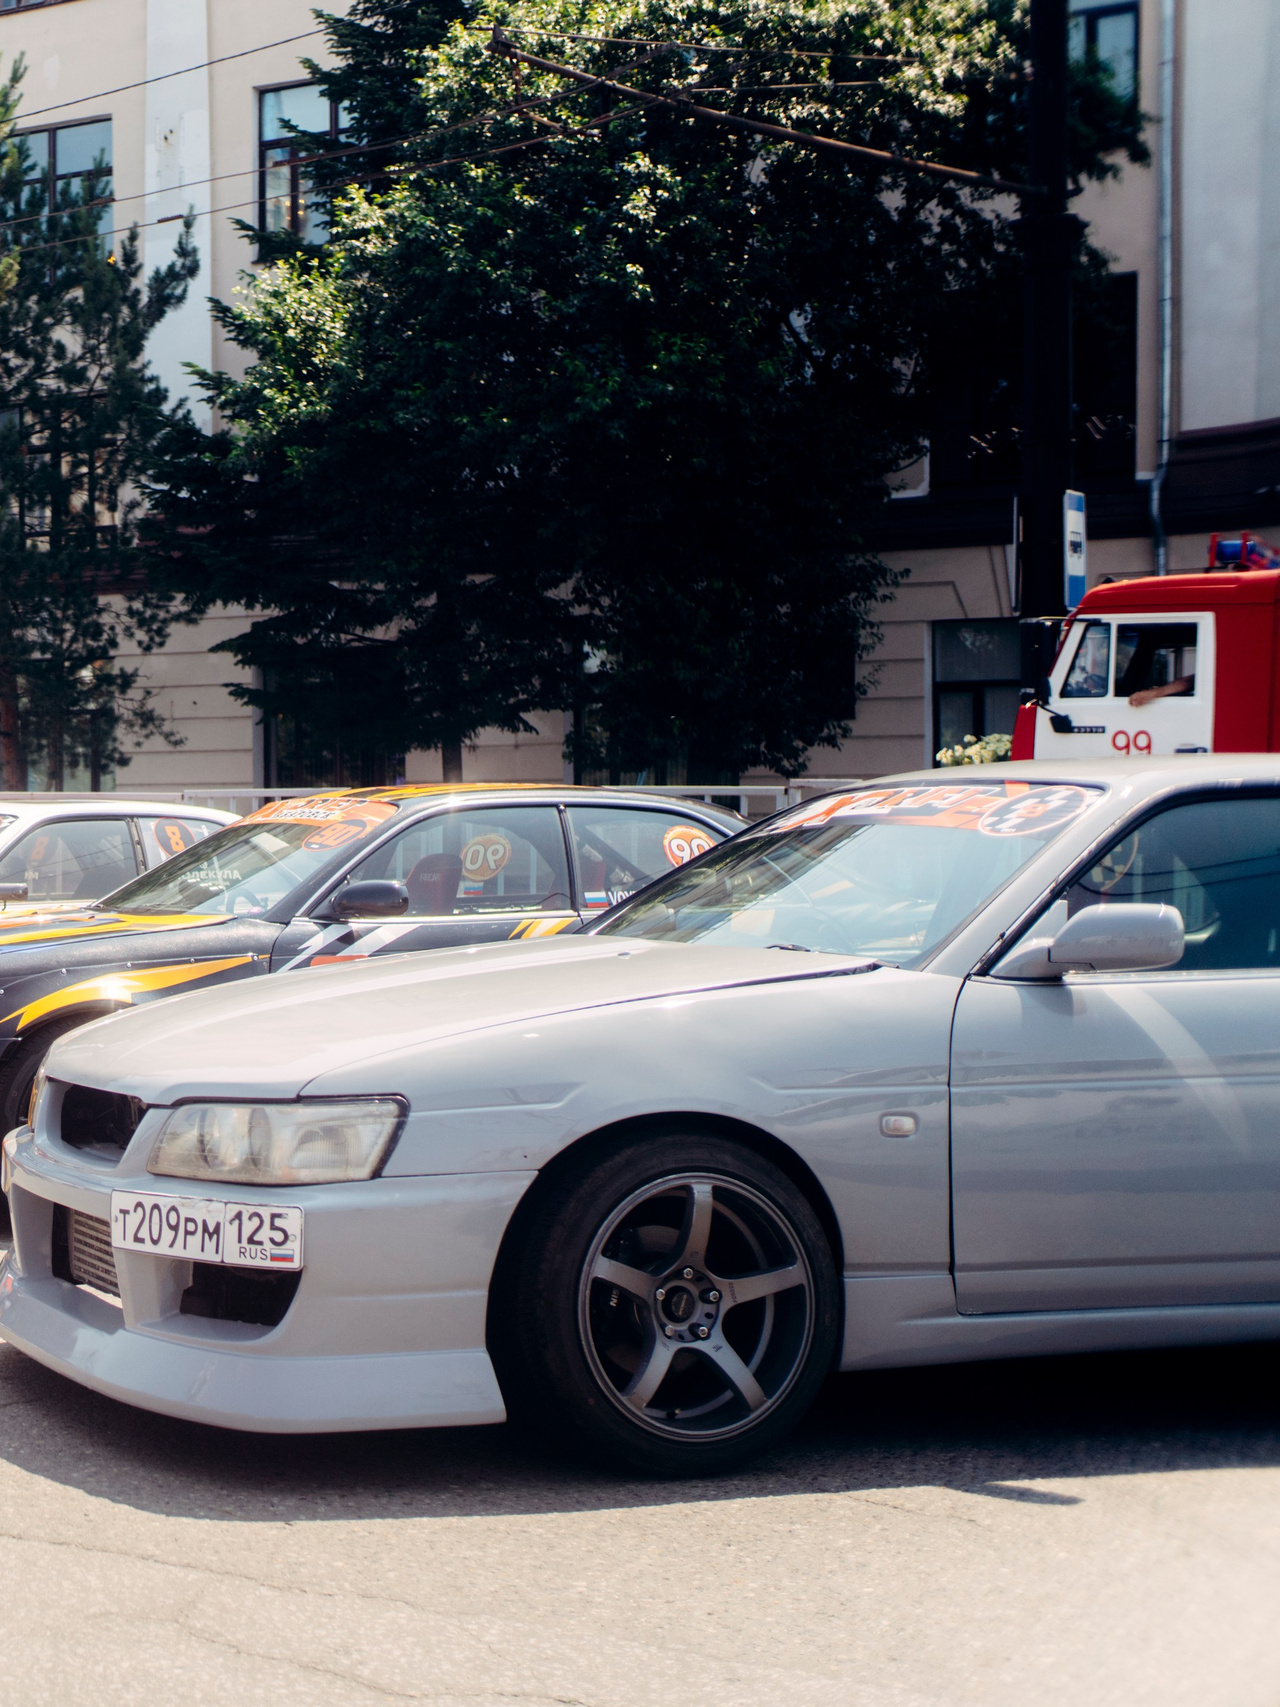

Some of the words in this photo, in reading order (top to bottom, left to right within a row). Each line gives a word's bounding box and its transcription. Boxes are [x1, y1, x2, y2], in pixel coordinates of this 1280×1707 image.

[1111, 730, 1152, 755] 99
[164, 825, 186, 852] 8
[177, 870, 242, 881] ОЛЕКУЛА
[119, 1201, 221, 1255] Т209РМ
[228, 1210, 290, 1247] 125
[238, 1246, 268, 1261] RUS
